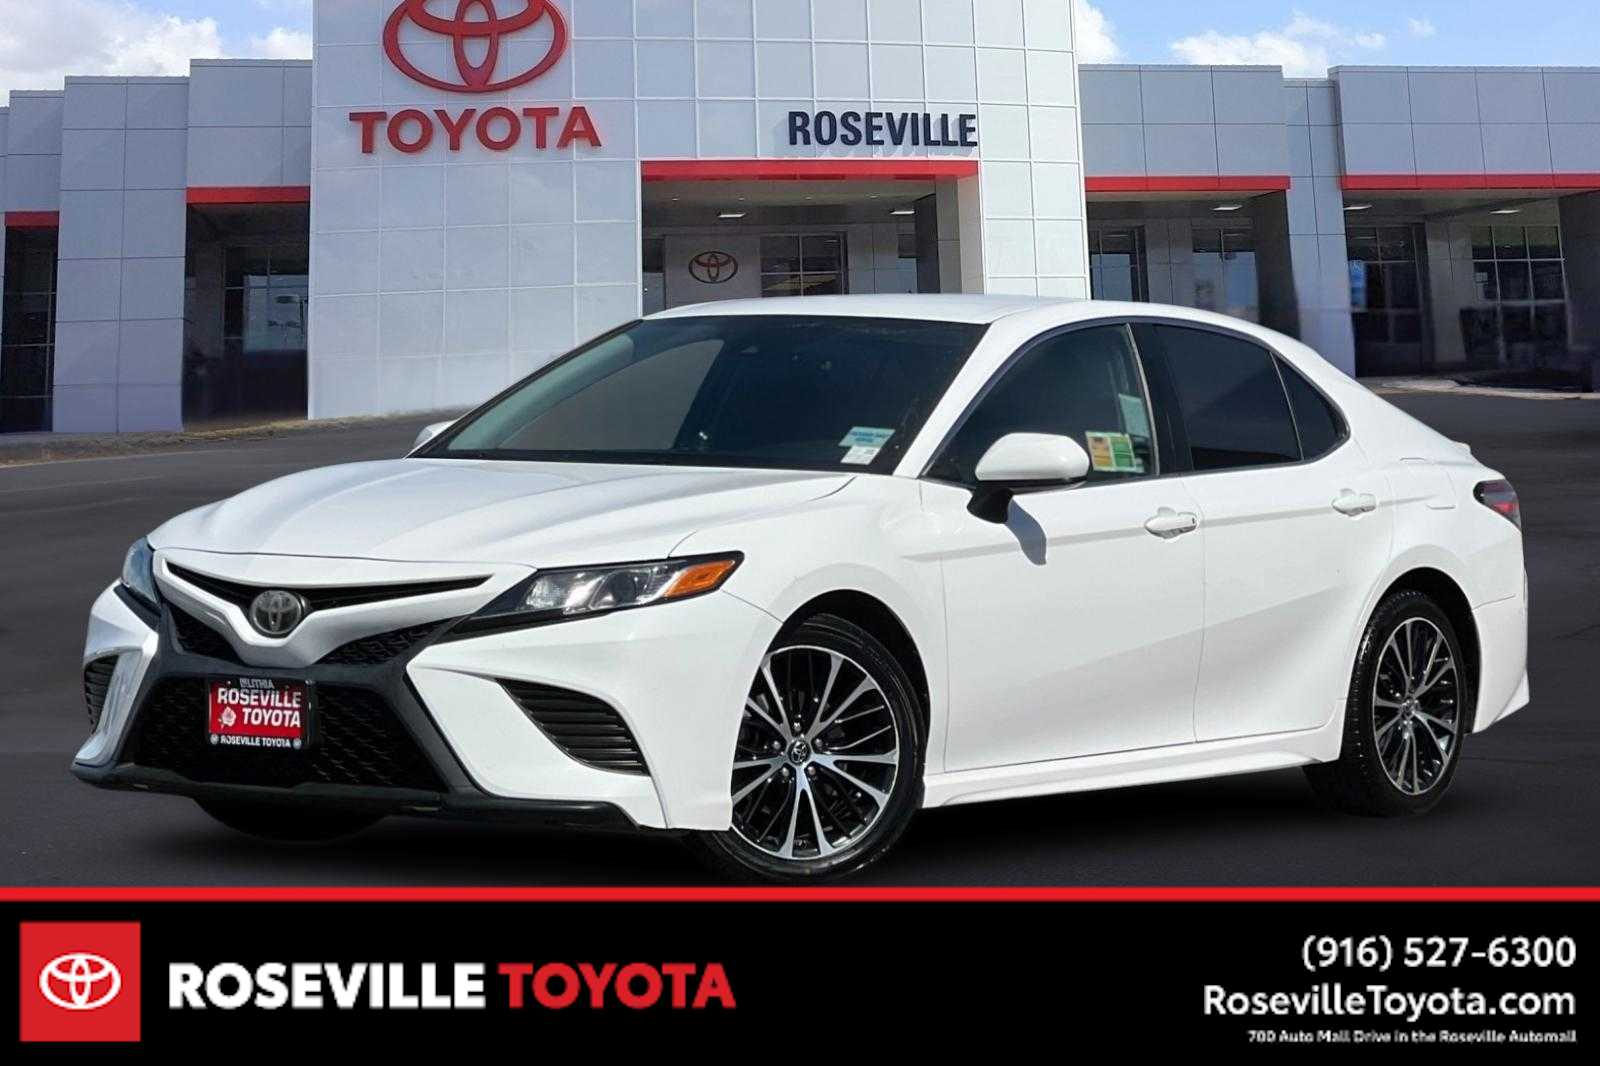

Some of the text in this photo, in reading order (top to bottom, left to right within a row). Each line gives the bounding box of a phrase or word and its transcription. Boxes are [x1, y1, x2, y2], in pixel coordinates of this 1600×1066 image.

[349, 106, 602, 154] TOYOTA
[788, 111, 979, 147] ROSEVILLE
[217, 687, 302, 708] ROSEVILLE
[242, 708, 301, 727] TOYOTA
[220, 735, 291, 748] ROSEVILLE TOYOTA
